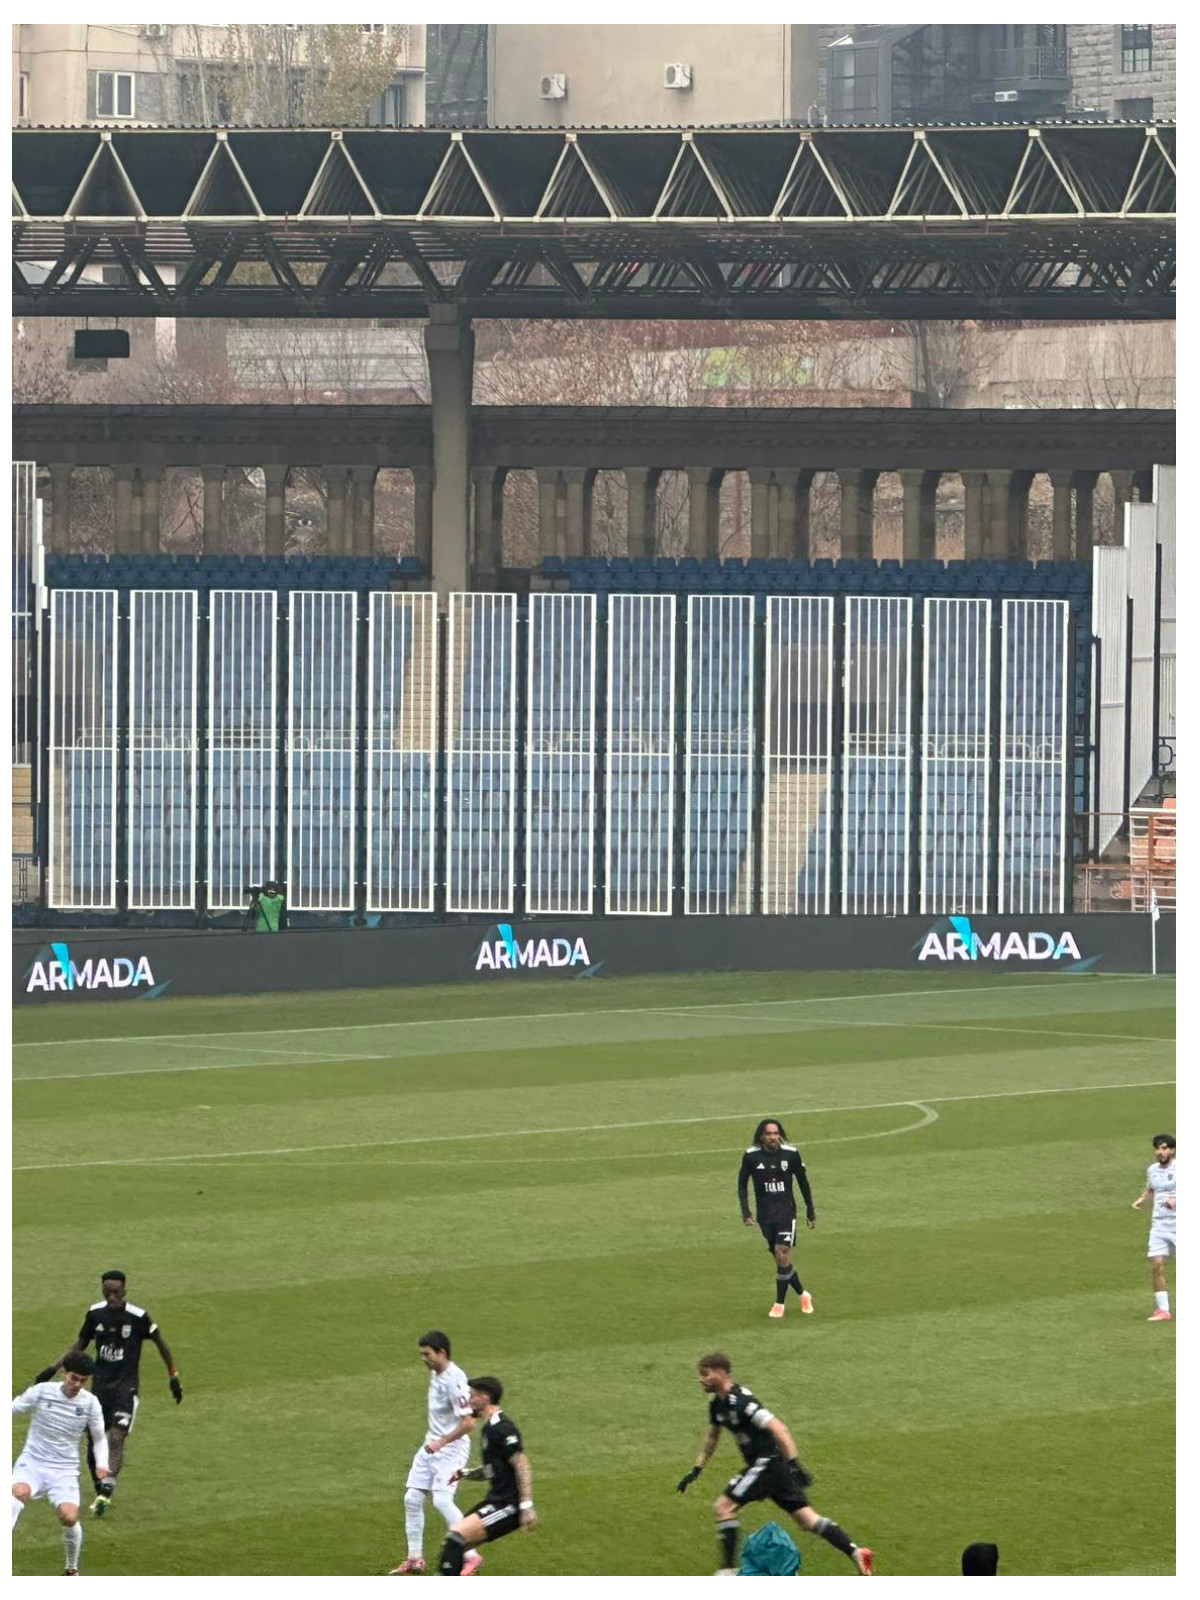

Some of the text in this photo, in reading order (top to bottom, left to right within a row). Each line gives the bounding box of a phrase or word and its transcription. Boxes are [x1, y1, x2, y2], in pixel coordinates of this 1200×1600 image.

[475, 937, 591, 971] ARMADA
[917, 931, 1082, 961] ARMADA
[26, 955, 155, 993] ARMADA
